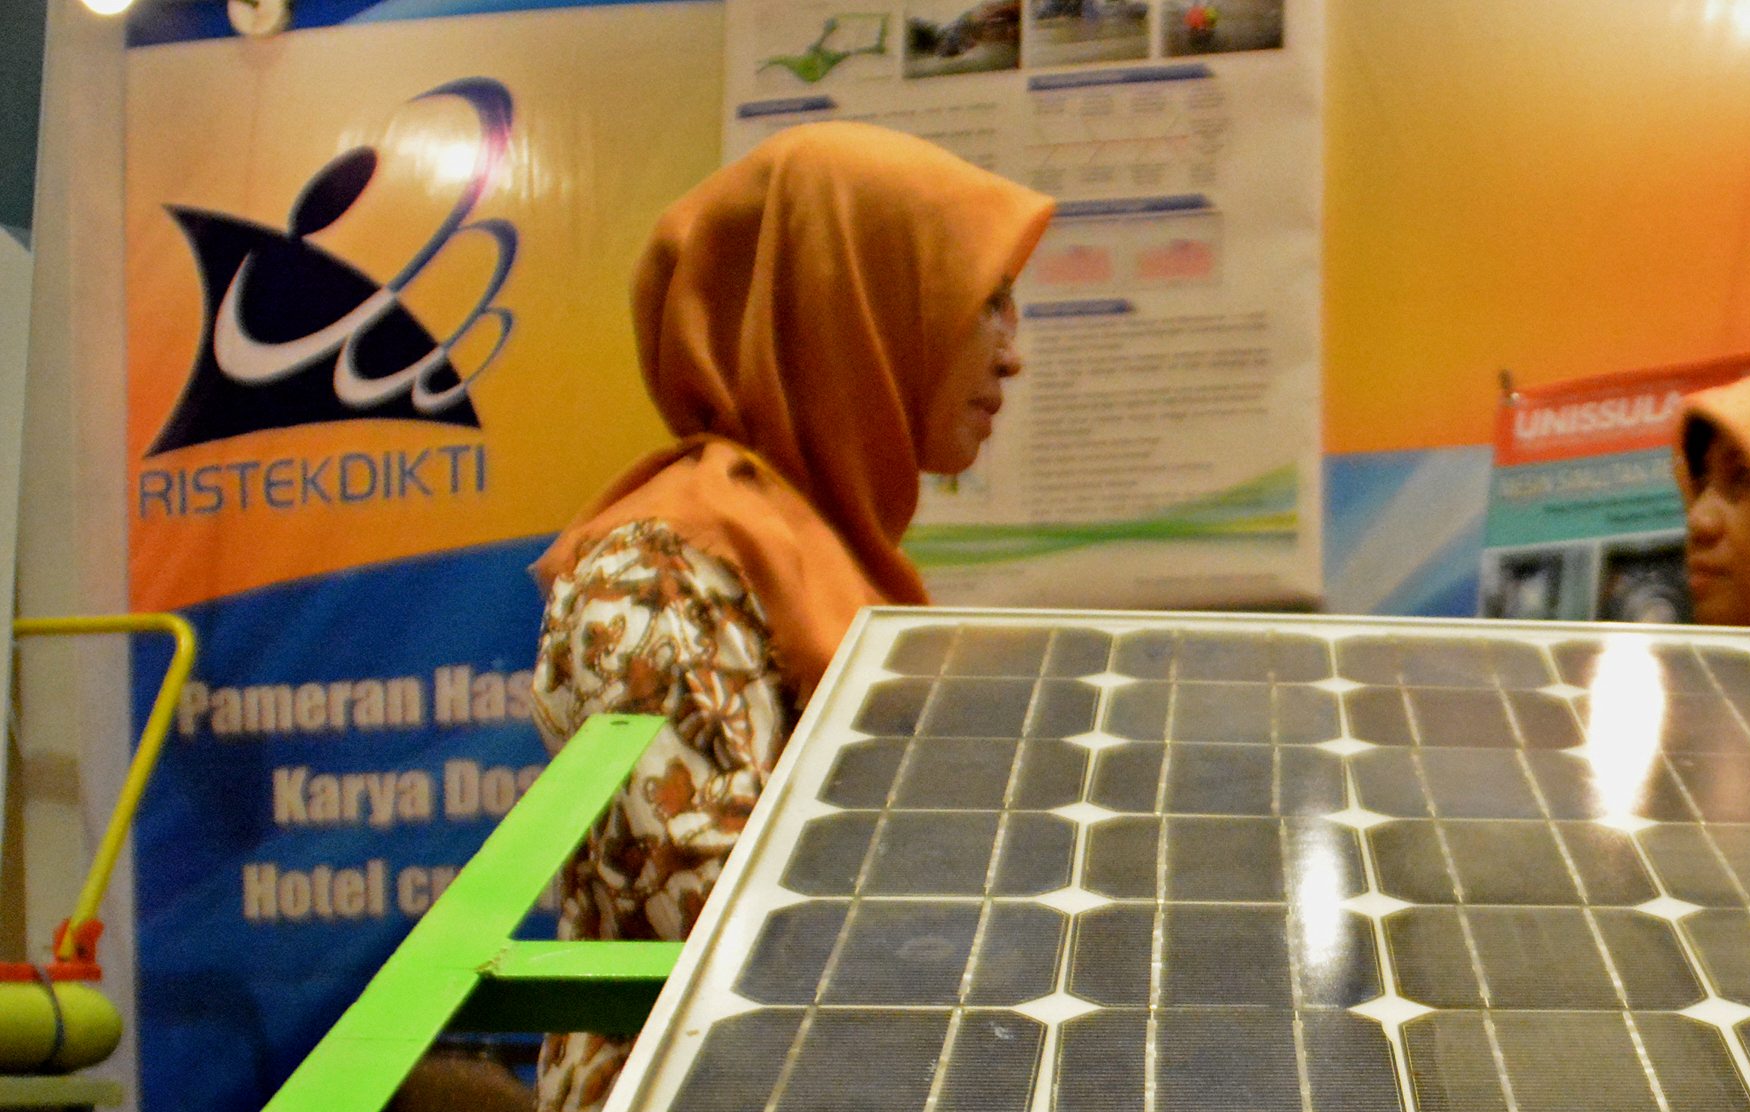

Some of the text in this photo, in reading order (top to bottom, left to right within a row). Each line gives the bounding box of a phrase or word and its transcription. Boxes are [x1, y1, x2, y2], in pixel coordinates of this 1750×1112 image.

[138, 444, 485, 518] RISTEKDIKTI
[178, 664, 535, 738] Pameran Has
[272, 763, 433, 829] Karya
[242, 858, 386, 921] Hotel
